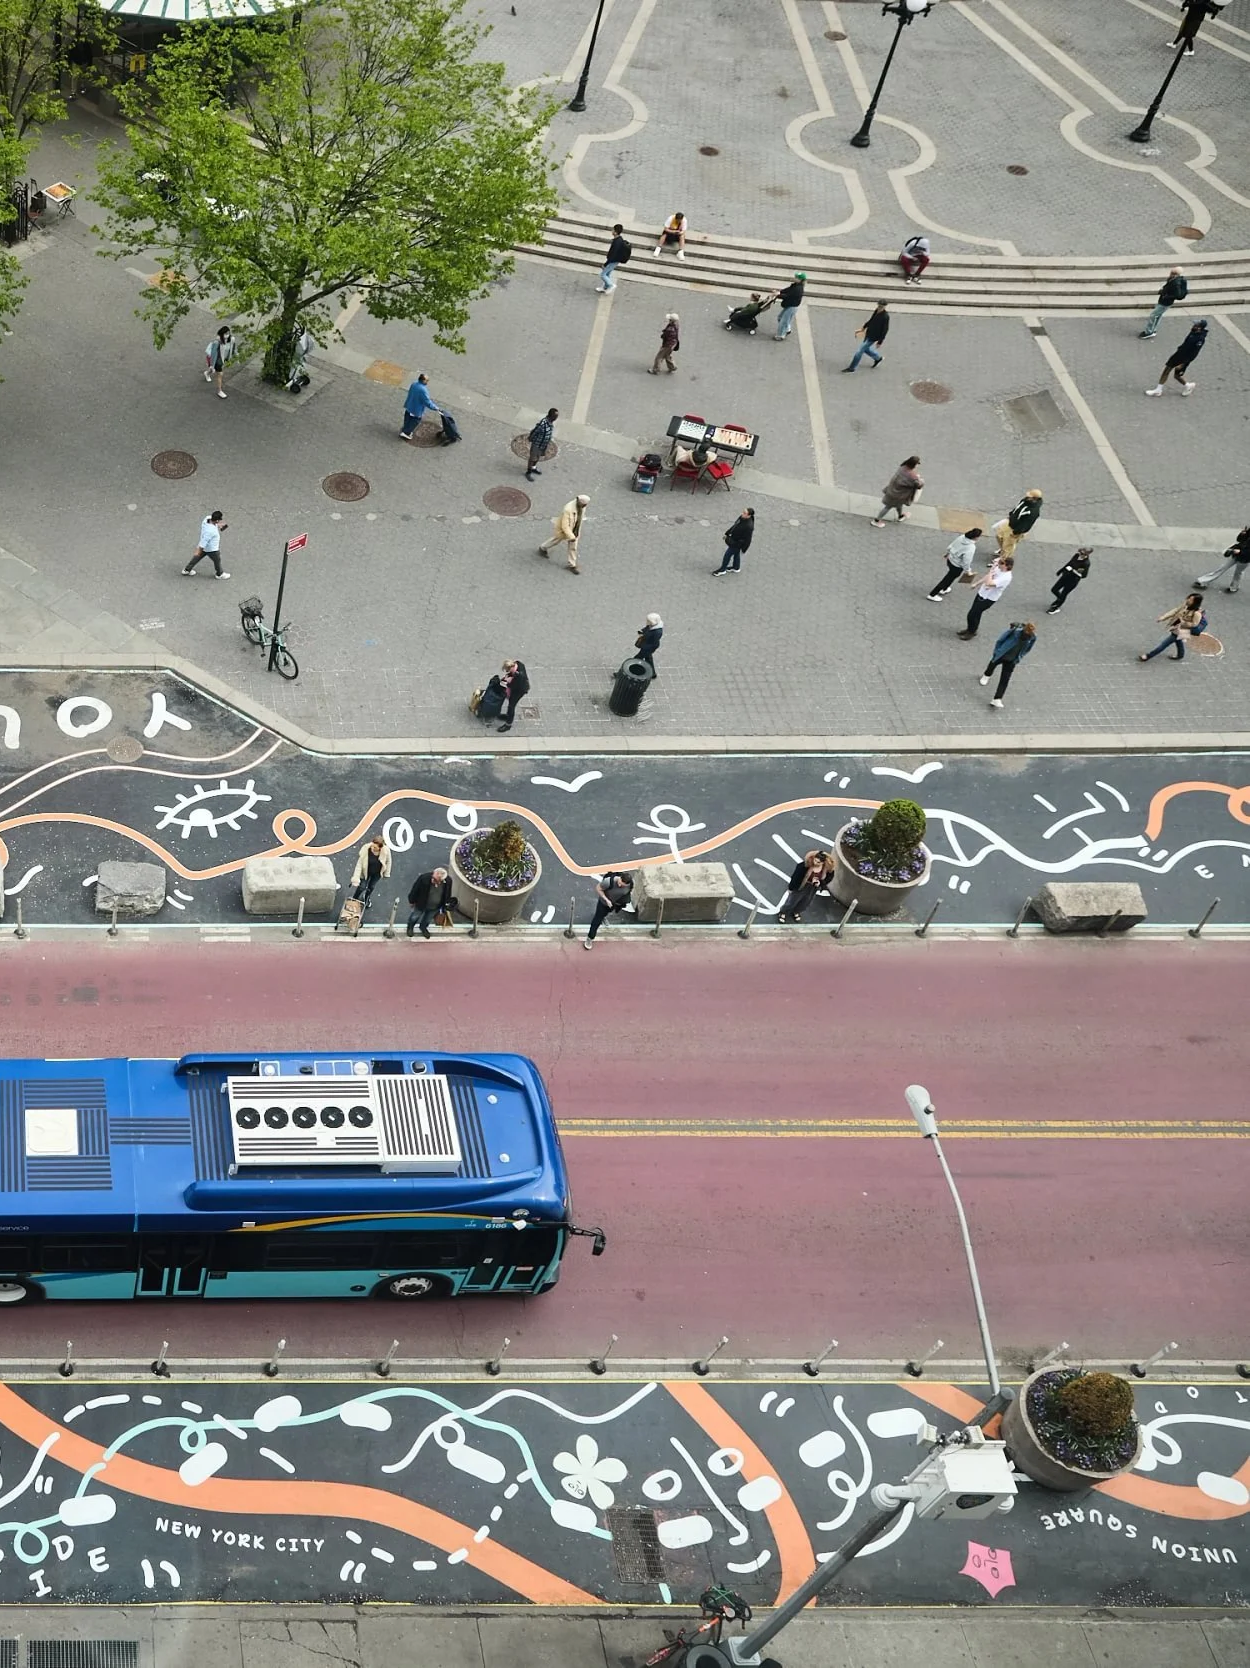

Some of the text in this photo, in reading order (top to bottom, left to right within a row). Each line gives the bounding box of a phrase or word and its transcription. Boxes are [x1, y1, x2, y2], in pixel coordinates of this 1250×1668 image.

[155, 1517, 325, 1553] NEW YORK CITY
[1040, 1507, 1238, 1564] UNION SQUARE
